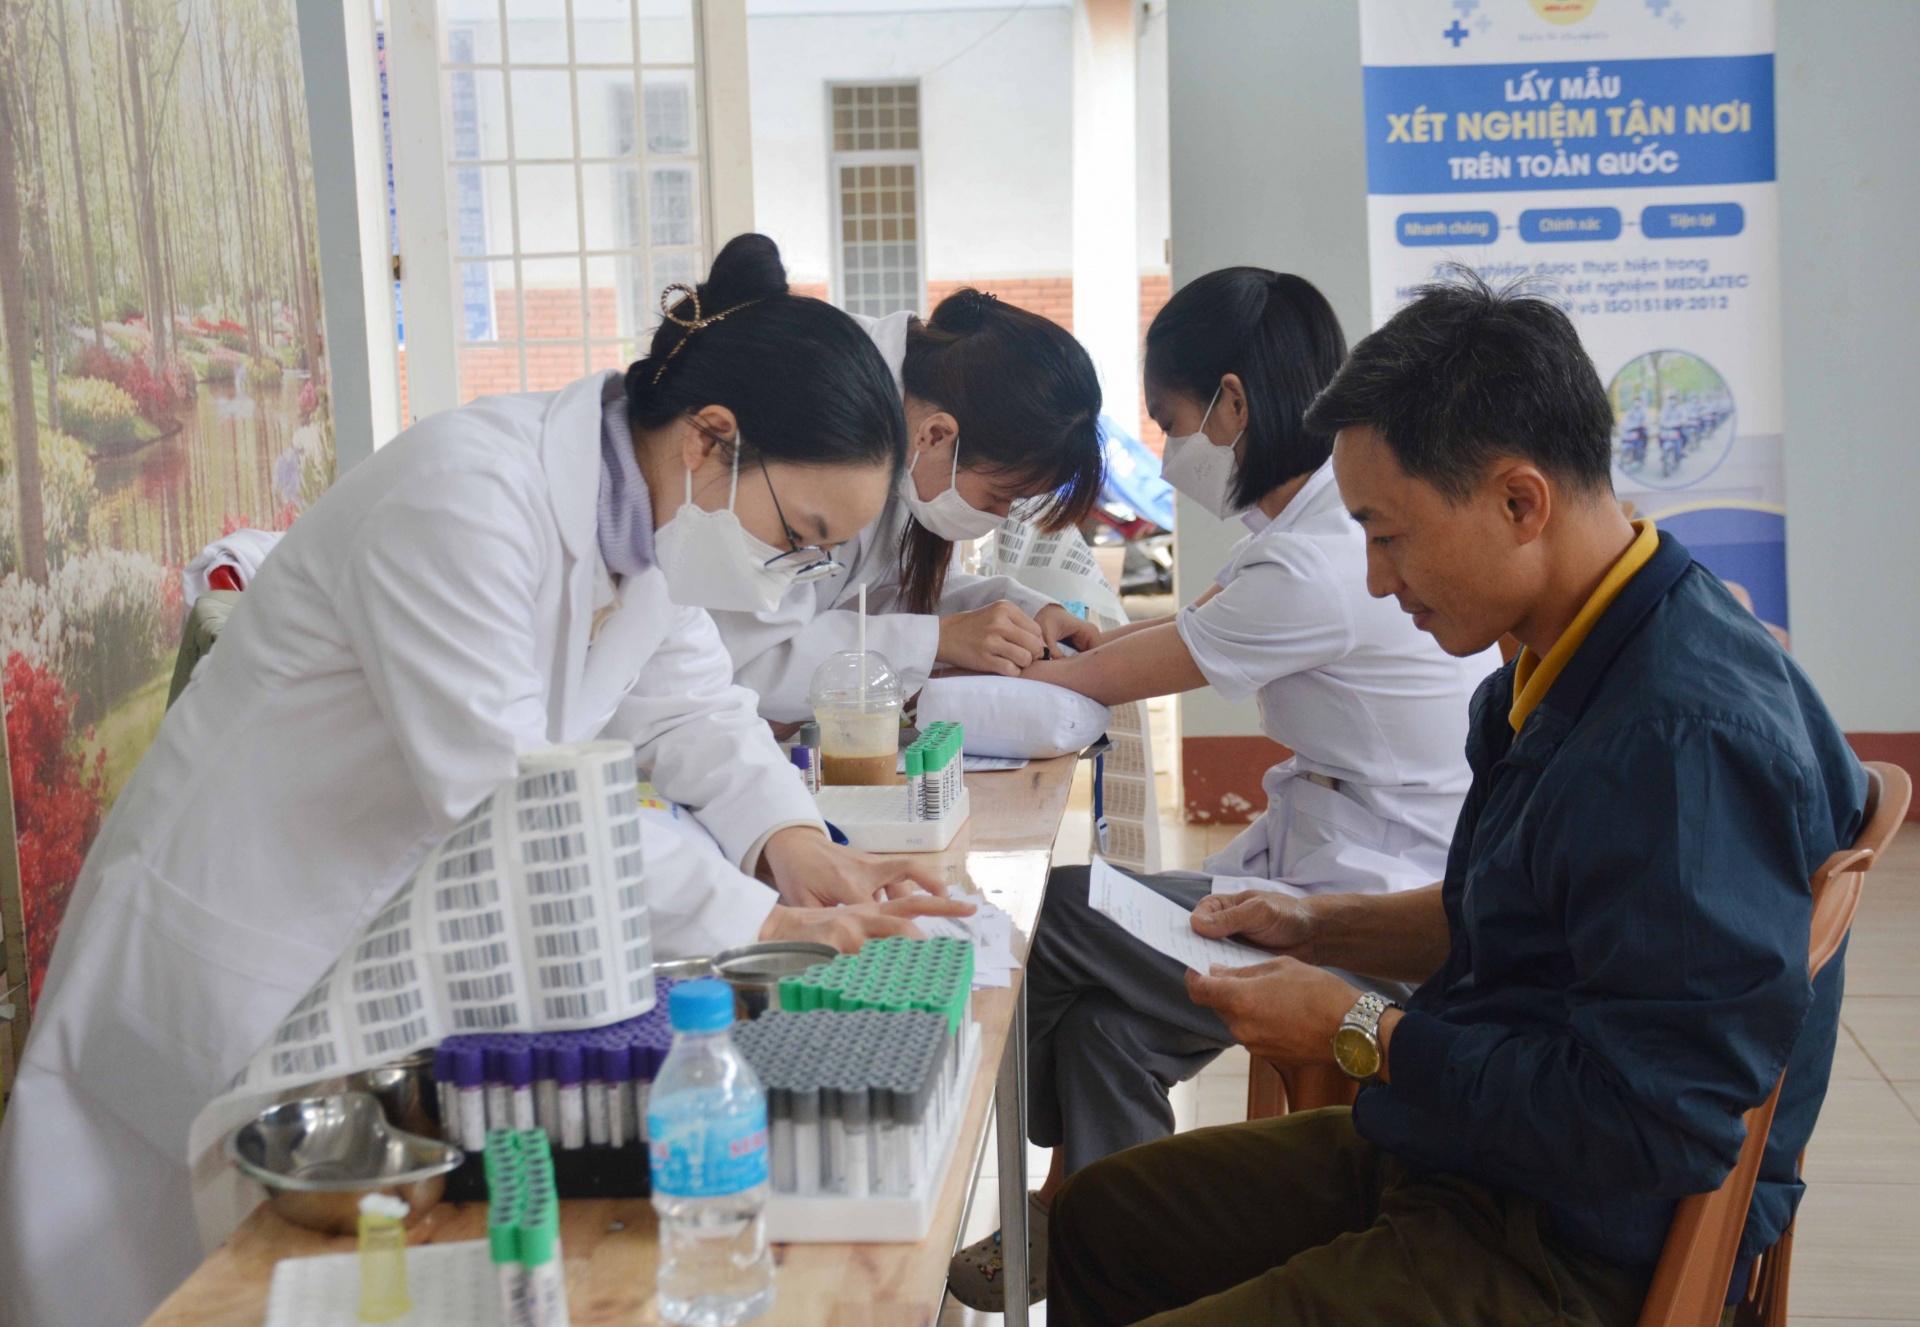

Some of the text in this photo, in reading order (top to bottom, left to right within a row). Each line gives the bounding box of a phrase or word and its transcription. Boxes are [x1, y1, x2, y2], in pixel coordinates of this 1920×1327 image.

[1505, 67, 1621, 101] LẤY MẪU
[1386, 99, 1752, 147] XÉT NGHIỆM TẬN NƠI
[1449, 151, 1512, 180] TRÊN
[1596, 142, 1680, 176] QUỐC
[1664, 274, 1748, 290] MEDLATEC
